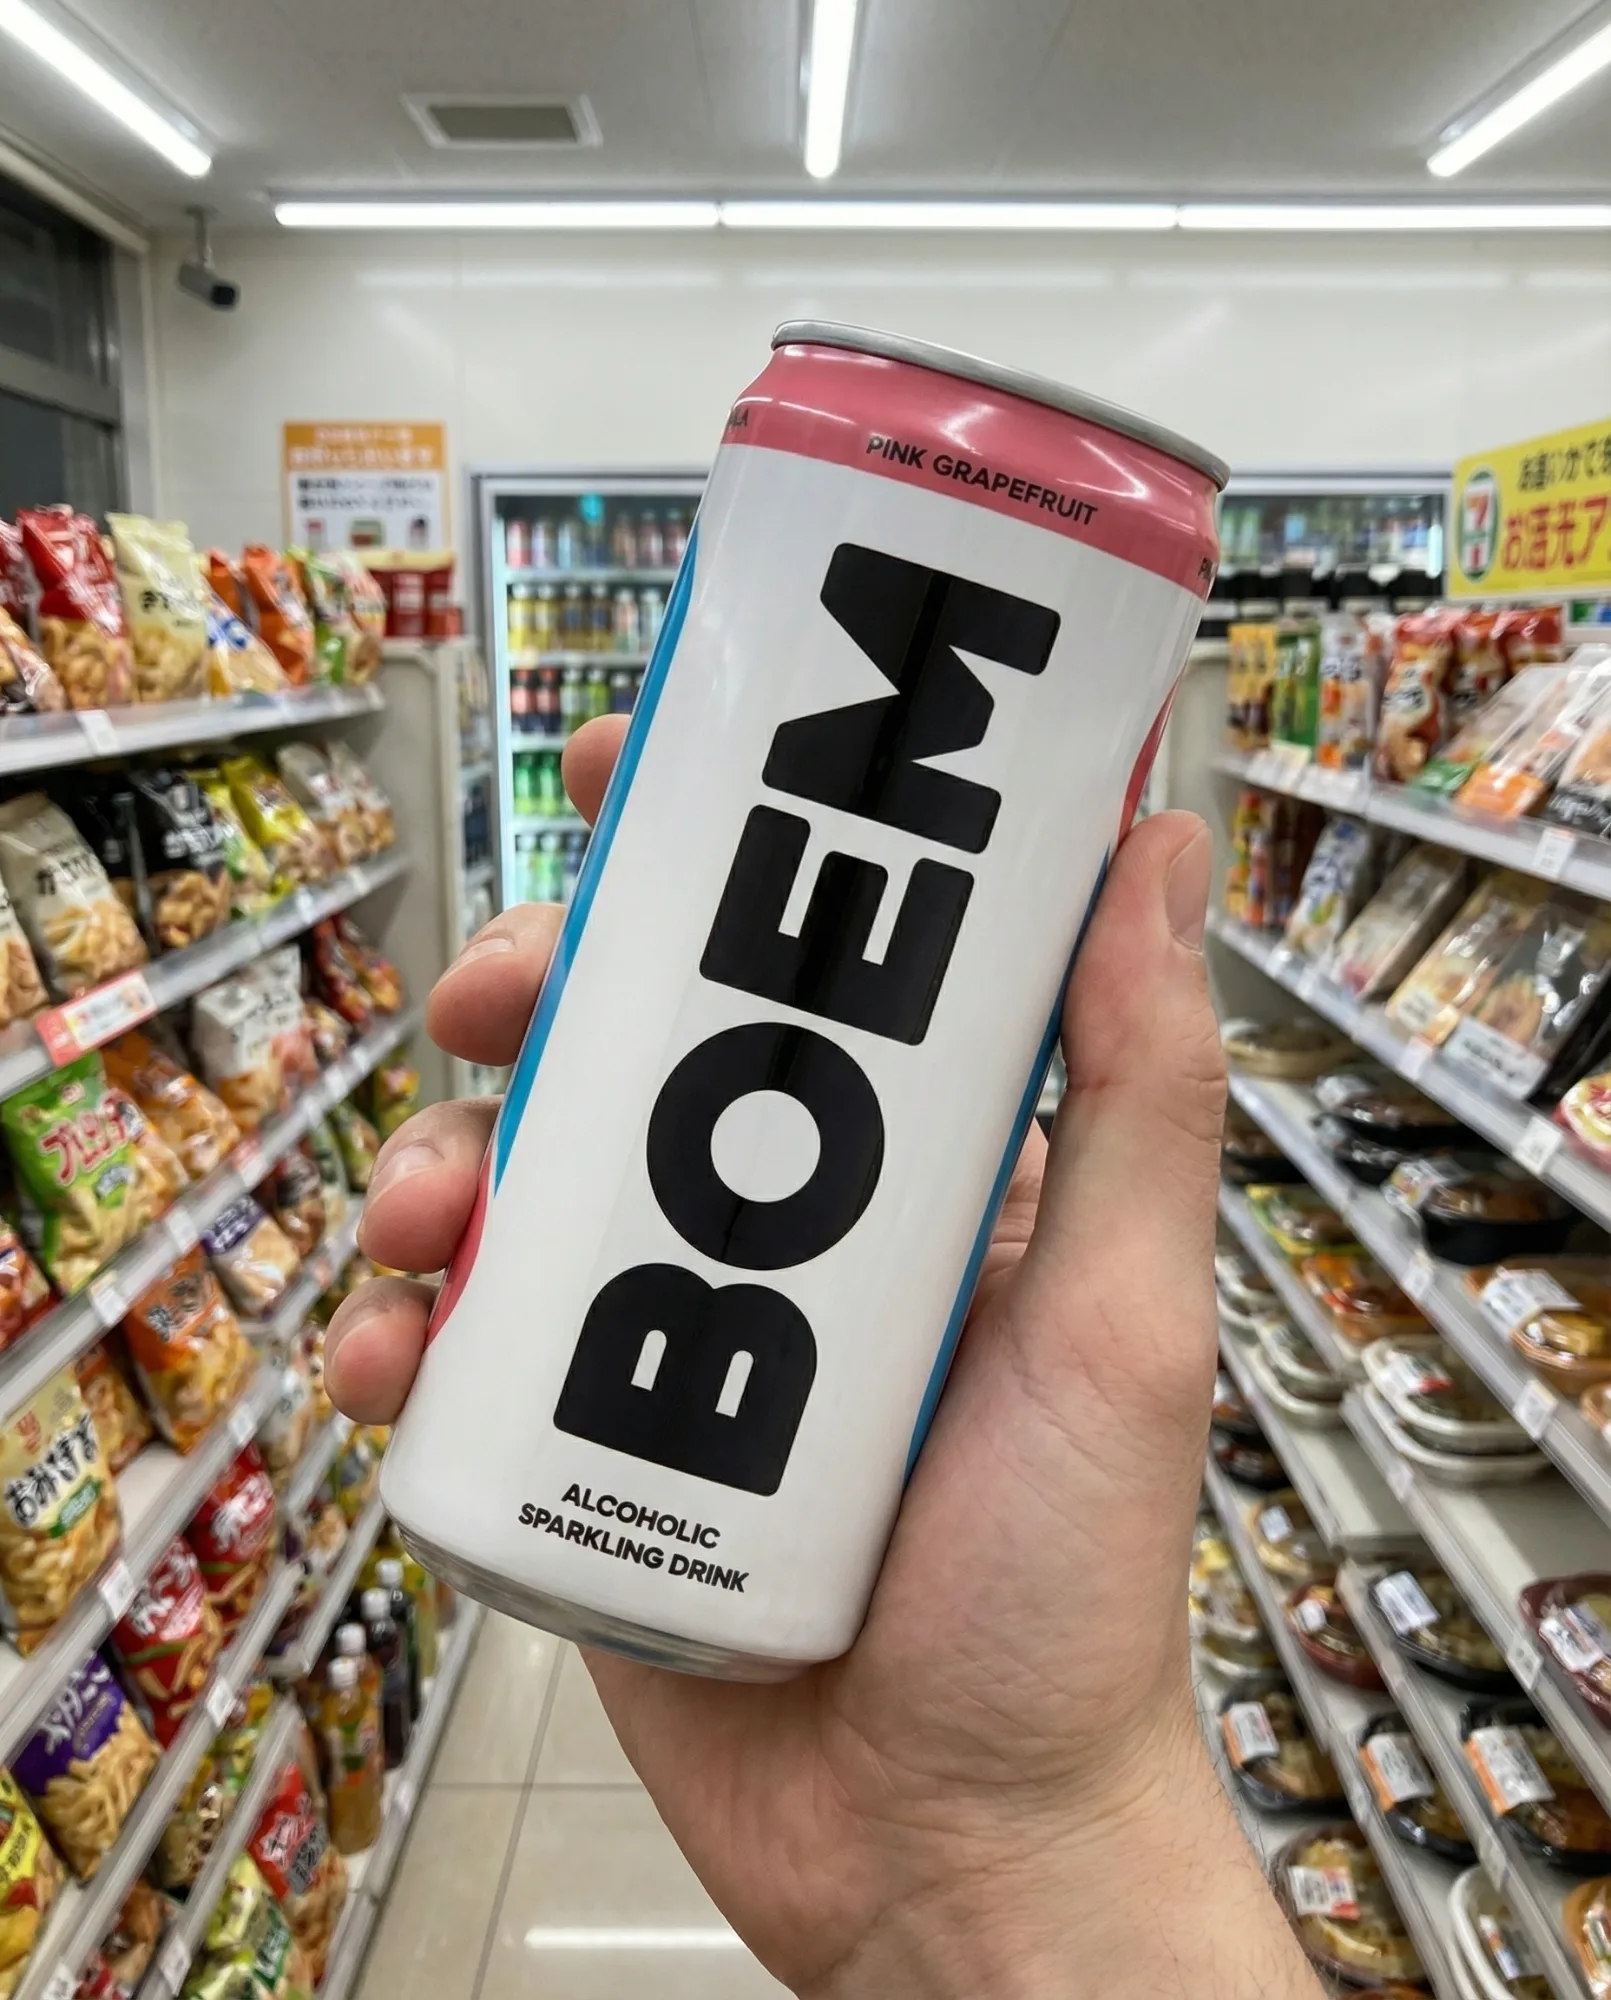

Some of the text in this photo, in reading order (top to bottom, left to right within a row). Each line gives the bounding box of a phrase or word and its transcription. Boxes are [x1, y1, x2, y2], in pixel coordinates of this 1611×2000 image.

[865, 435, 1099, 526] PINK GRAPEFRUIT
[553, 542, 1061, 1497] BOEM
[518, 1503, 749, 1593] SPARKLING DRINK
[561, 1483, 721, 1549] ALCOHOLIC
